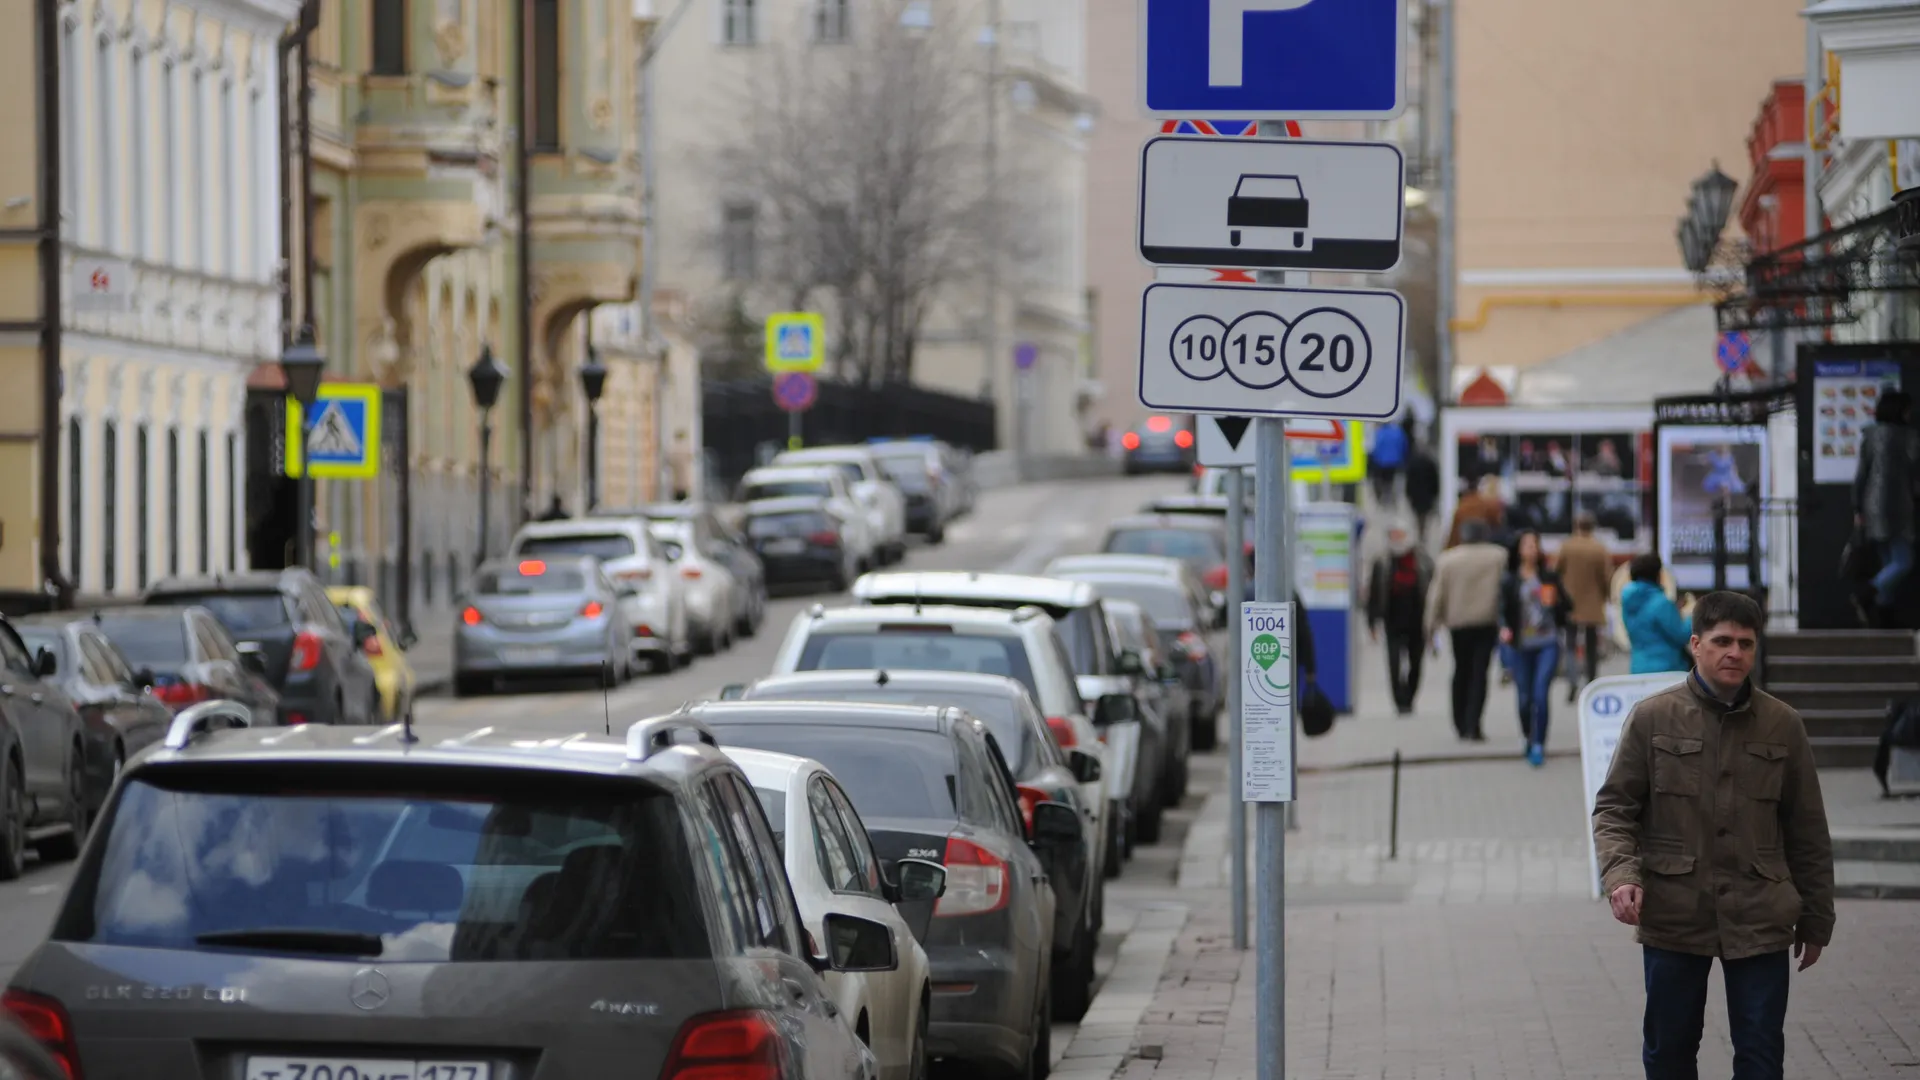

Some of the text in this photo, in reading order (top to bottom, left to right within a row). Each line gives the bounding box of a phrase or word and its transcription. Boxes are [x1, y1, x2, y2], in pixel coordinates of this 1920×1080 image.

[1180, 333, 1355, 373] 10 15 20
[1247, 616, 1286, 632] 1004
[907, 848, 938, 858] SX4
[85, 984, 246, 1002] GLK 220 CDI
